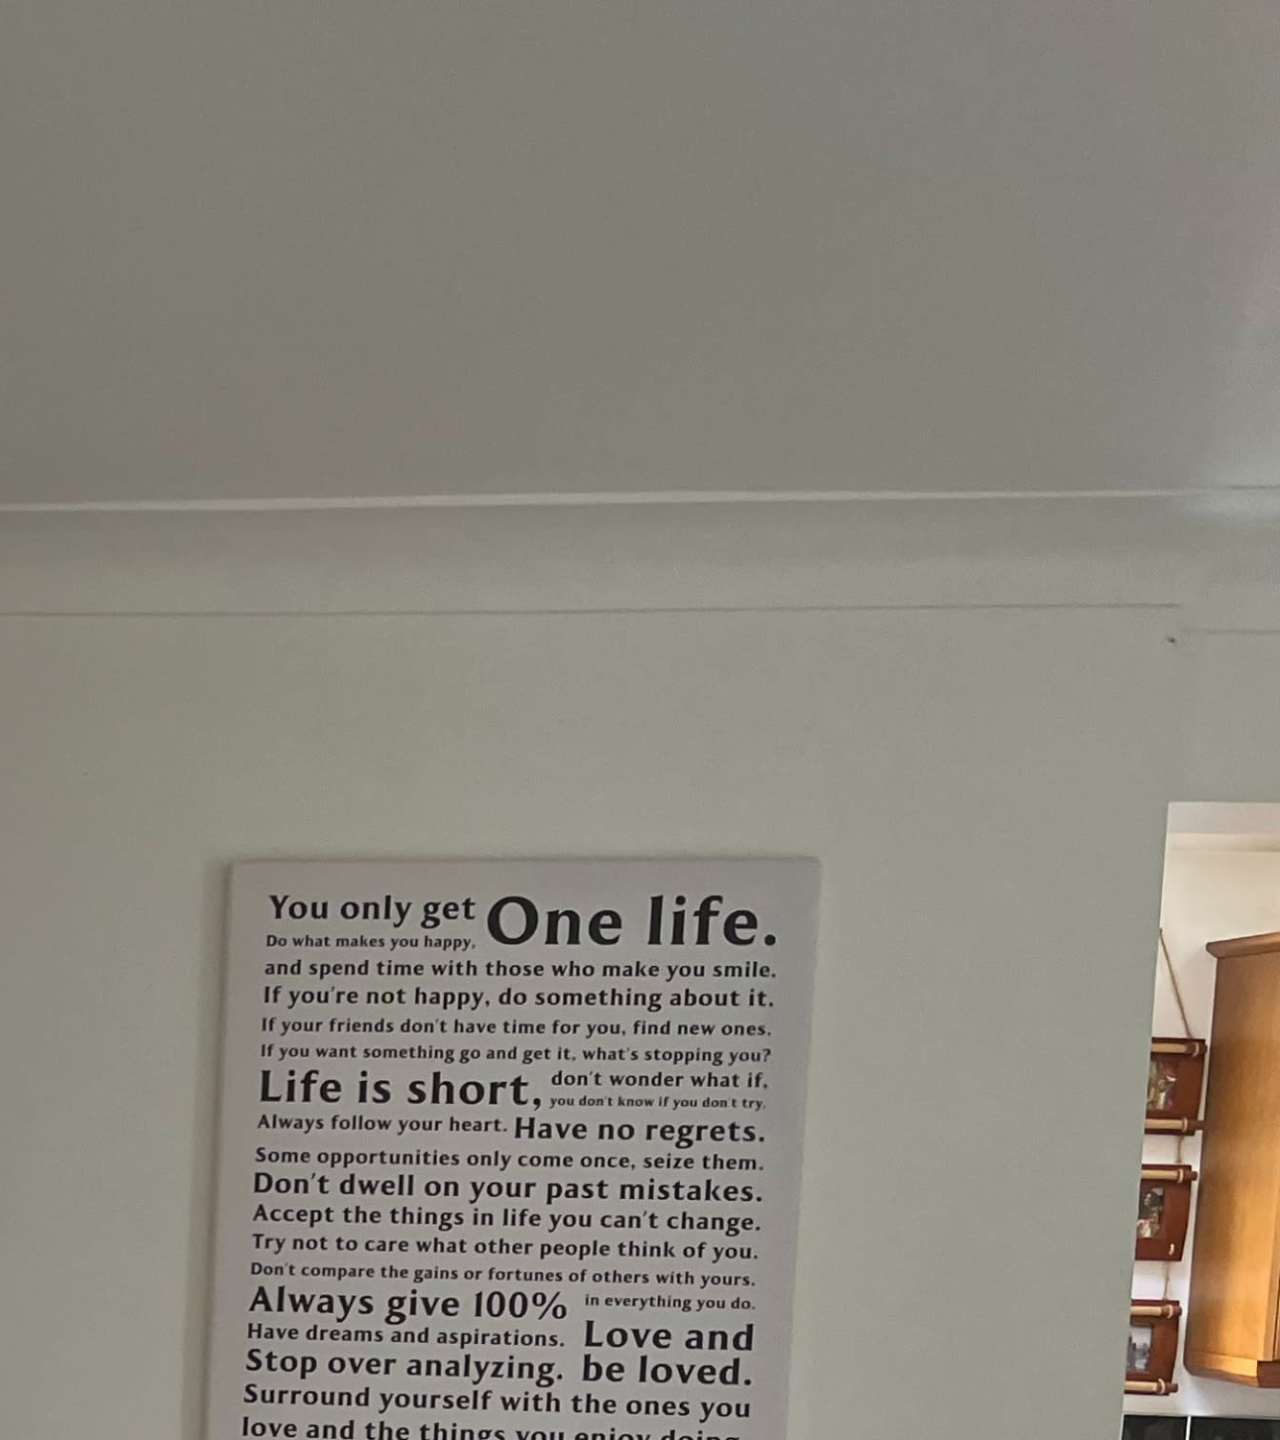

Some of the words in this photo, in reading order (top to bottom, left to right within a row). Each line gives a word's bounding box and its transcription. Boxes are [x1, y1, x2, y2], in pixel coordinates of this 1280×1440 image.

[267, 893, 329, 921] You
[339, 893, 414, 930] only
[419, 896, 477, 931] get
[486, 895, 624, 947] One
[646, 893, 777, 947] life.
[265, 933, 288, 948] Do
[291, 933, 332, 948] what
[334, 933, 386, 949] makes
[388, 937, 420, 953] you
[423, 934, 477, 953] happy,
[263, 958, 303, 977] and
[307, 958, 370, 982] spend
[375, 958, 425, 977] time
[430, 958, 479, 978] with
[484, 959, 545, 978] those
[550, 959, 596, 978] who
[600, 959, 661, 978] make
[664, 963, 706, 984] you
[711, 960, 777, 979] smile.
[263, 984, 284, 1005] If
[286, 984, 360, 1011] you're
[365, 987, 408, 1006] not
[413, 985, 491, 1012] happy,
[497, 986, 528, 1007] do
[533, 986, 664, 1014] something
[668, 986, 742, 1008] about
[747, 987, 775, 1008] it.
[260, 1016, 278, 1033] If
[279, 1020, 324, 1038] your
[328, 1016, 395, 1034] friends
[399, 1017, 448, 1035] don't
[452, 1017, 498, 1035] have
[501, 1018, 547, 1036] time
[551, 1018, 582, 1036] for
[584, 1022, 627, 1041] you,
[632, 1018, 672, 1036] find
[676, 1023, 717, 1037] new
[720, 1023, 772, 1037] ones.
[259, 1068, 343, 1104] Life
[357, 1069, 392, 1105] is
[406, 1069, 542, 1112] short,
[550, 1068, 603, 1087] don't
[608, 1070, 686, 1088] wonder
[688, 1070, 741, 1089] what
[746, 1071, 769, 1091] if,
[256, 1112, 325, 1136] Always
[330, 1113, 393, 1132] follow
[396, 1118, 444, 1137] your
[448, 1115, 509, 1133] heart.
[513, 1115, 589, 1141] Have
[597, 1122, 636, 1142] no
[644, 1120, 766, 1151] regrets.
[254, 1146, 312, 1165] Some
[315, 1148, 461, 1170] opportunities
[465, 1149, 513, 1173] only
[516, 1154, 575, 1169] come
[579, 1154, 637, 1172] once,
[641, 1151, 696, 1170] seize
[701, 1152, 765, 1172] them.
[252, 1171, 331, 1196] Don't
[338, 1172, 416, 1197] dwell
[423, 1179, 460, 1198] on
[467, 1180, 538, 1206] your
[545, 1178, 610, 1207] past
[618, 1176, 763, 1203] mistakes.
[251, 1202, 336, 1230] Accept
[341, 1204, 383, 1225] the
[388, 1205, 465, 1233] things
[471, 1206, 495, 1227] in
[501, 1207, 543, 1228] life
[546, 1212, 593, 1234] you
[599, 1209, 660, 1230] can't
[665, 1209, 762, 1239] change.
[247, 1284, 375, 1324] Always
[383, 1287, 461, 1327] give
[473, 1289, 568, 1321] 100%
[584, 1292, 601, 1307] in
[603, 1293, 693, 1314] everything
[694, 1298, 727, 1313] you
[729, 1295, 757, 1311] do.
[246, 1321, 300, 1341] Have
[304, 1323, 385, 1344] dreams
[389, 1325, 431, 1345] and
[435, 1327, 566, 1351] aspirations.
[583, 1319, 673, 1350] Love
[683, 1322, 755, 1352] and
[244, 1347, 318, 1381] Stop
[326, 1355, 398, 1376] over
[405, 1352, 564, 1389] analyzing.
[581, 1352, 626, 1384] be
[637, 1353, 753, 1387] loved.
[242, 1382, 371, 1408] Surround
[377, 1388, 494, 1416] yourself
[499, 1389, 561, 1414] with
[569, 1391, 618, 1416] the
[625, 1398, 691, 1417] ones
[697, 1400, 751, 1425] you
[241, 1415, 299, 1439] love
[304, 1418, 356, 1440] and
